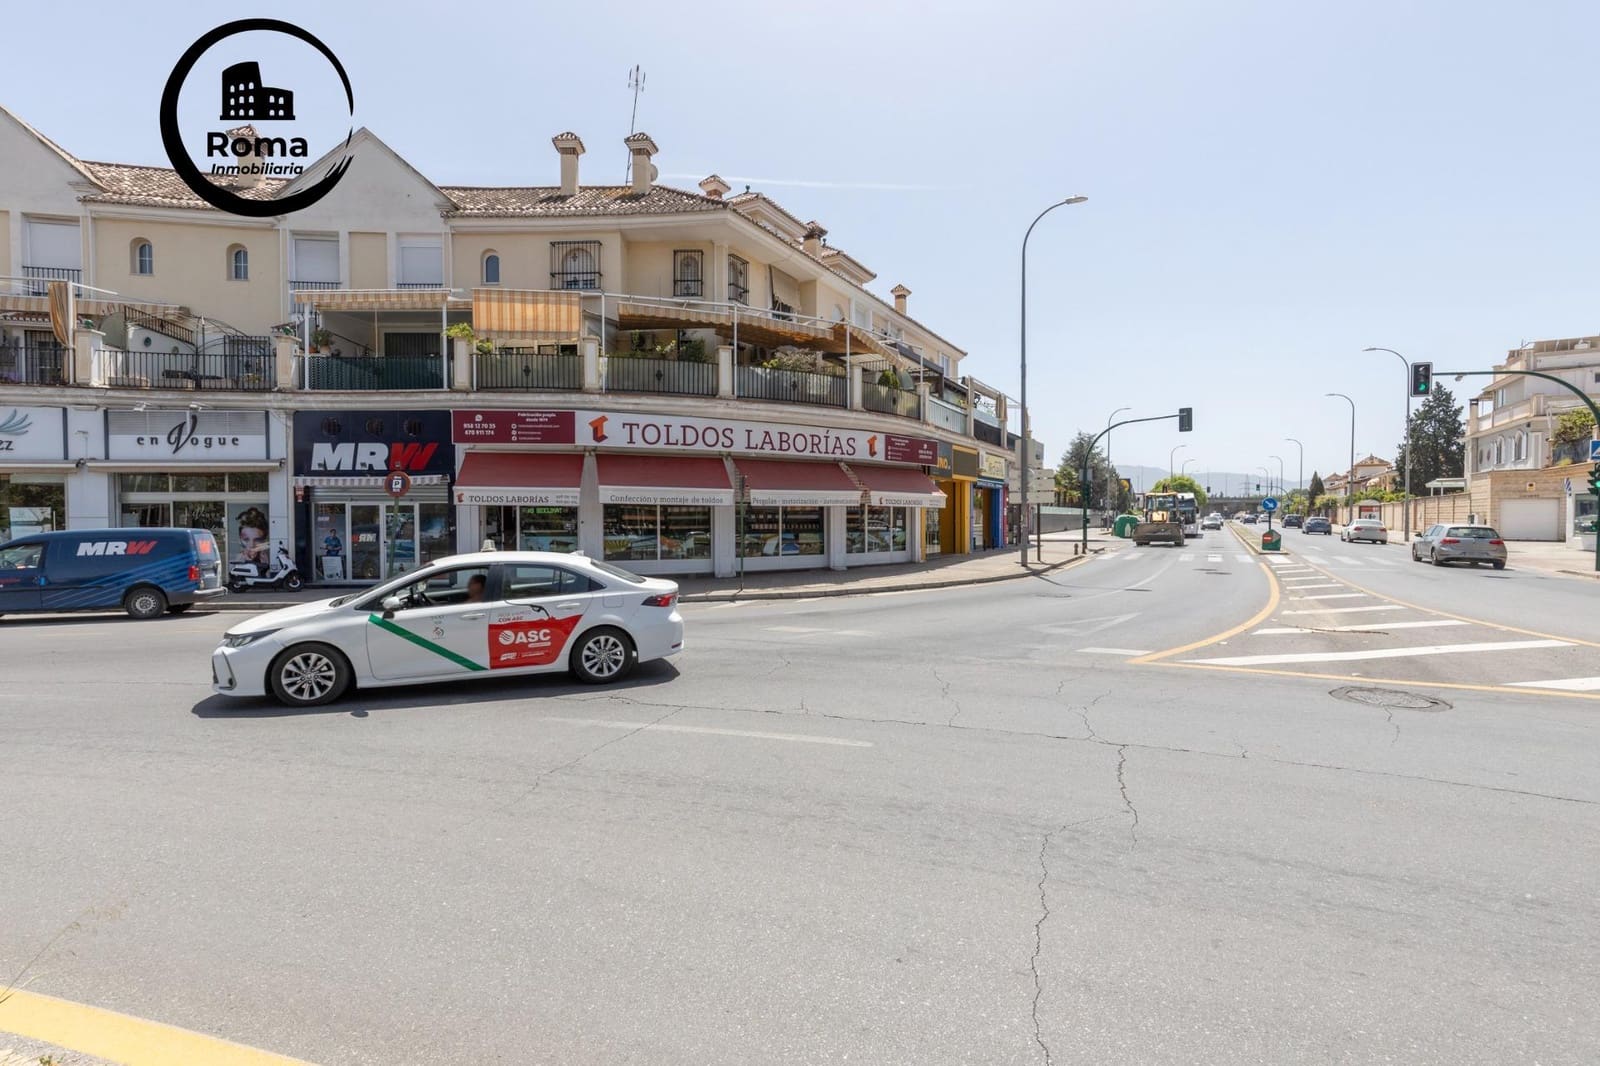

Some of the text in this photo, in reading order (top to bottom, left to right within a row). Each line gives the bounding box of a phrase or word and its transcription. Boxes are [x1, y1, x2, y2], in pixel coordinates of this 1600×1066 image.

[137, 414, 240, 454] en Vogue
[622, 422, 856, 456] TOLDOS LABORÍAS
[311, 442, 439, 471] MRW
[468, 495, 504, 503] TOLDOS
[506, 495, 550, 503] LABORÍAS
[610, 494, 652, 503] Confección
[659, 495, 689, 504] montaje
[691, 496, 699, 504] de
[701, 496, 723, 504] toldos
[77, 541, 157, 556] MRW
[515, 628, 551, 644] ASC
